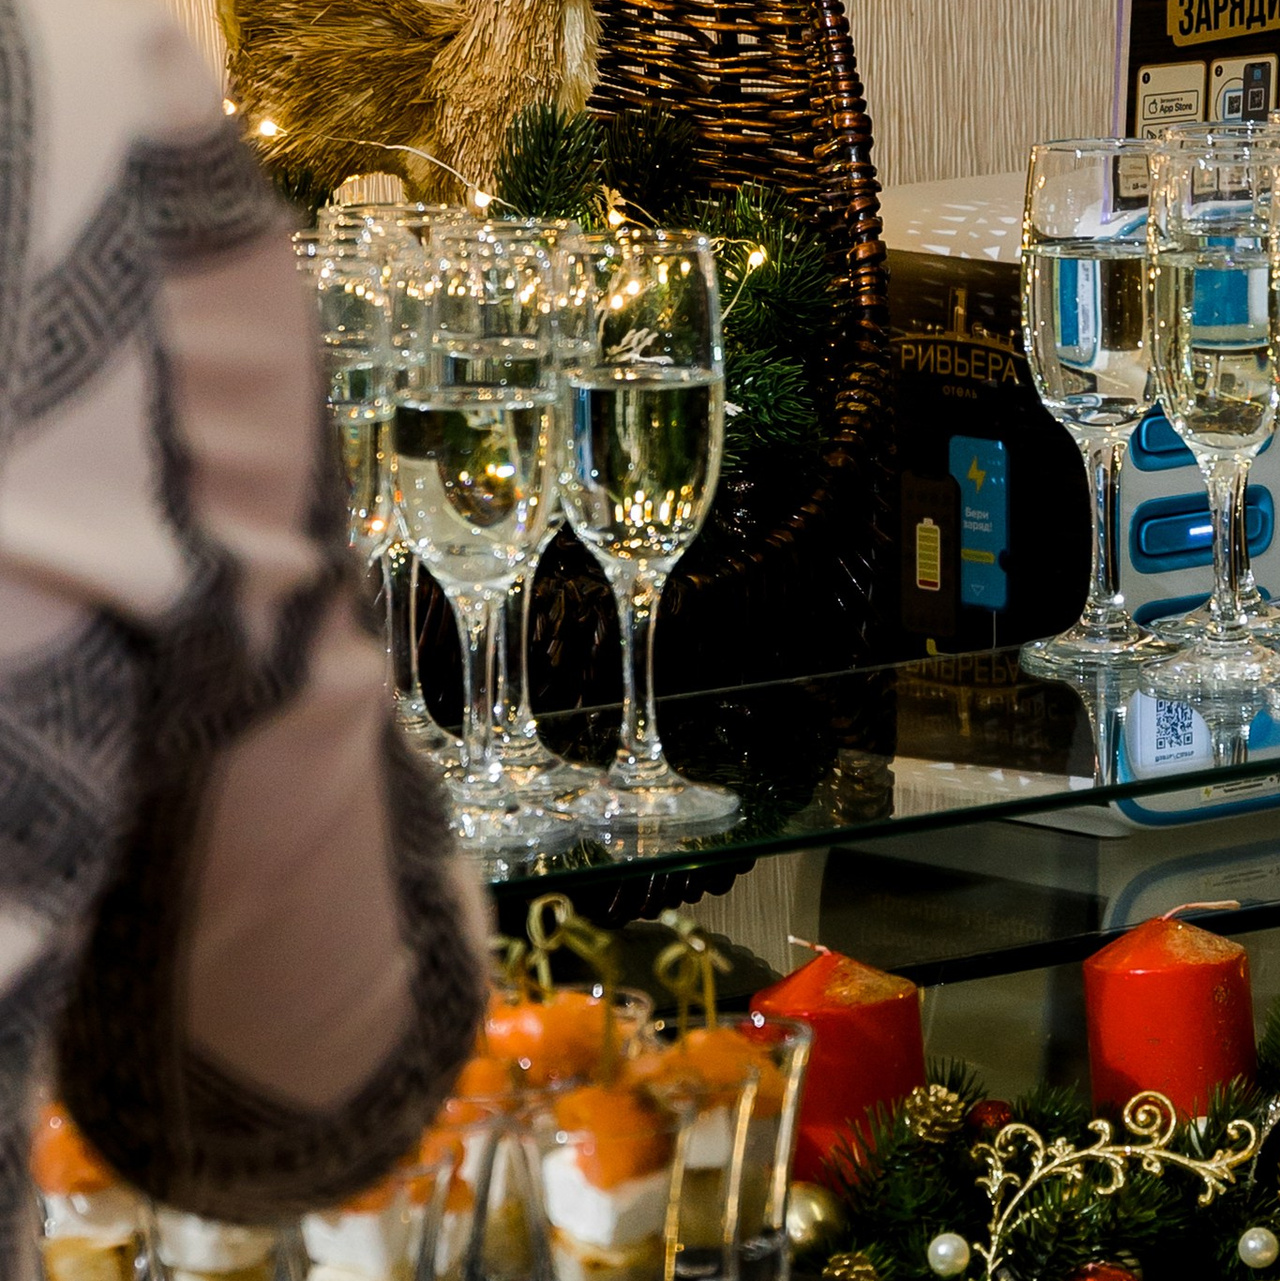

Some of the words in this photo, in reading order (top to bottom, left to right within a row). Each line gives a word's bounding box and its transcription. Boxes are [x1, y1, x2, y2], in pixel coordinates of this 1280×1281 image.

[1159, 104, 1174, 114] App
[1175, 102, 1193, 112] Store
[901, 344, 1020, 385] РИВЬЕРА
[965, 506, 990, 520] Бери
[963, 514, 993, 533] заряд!
